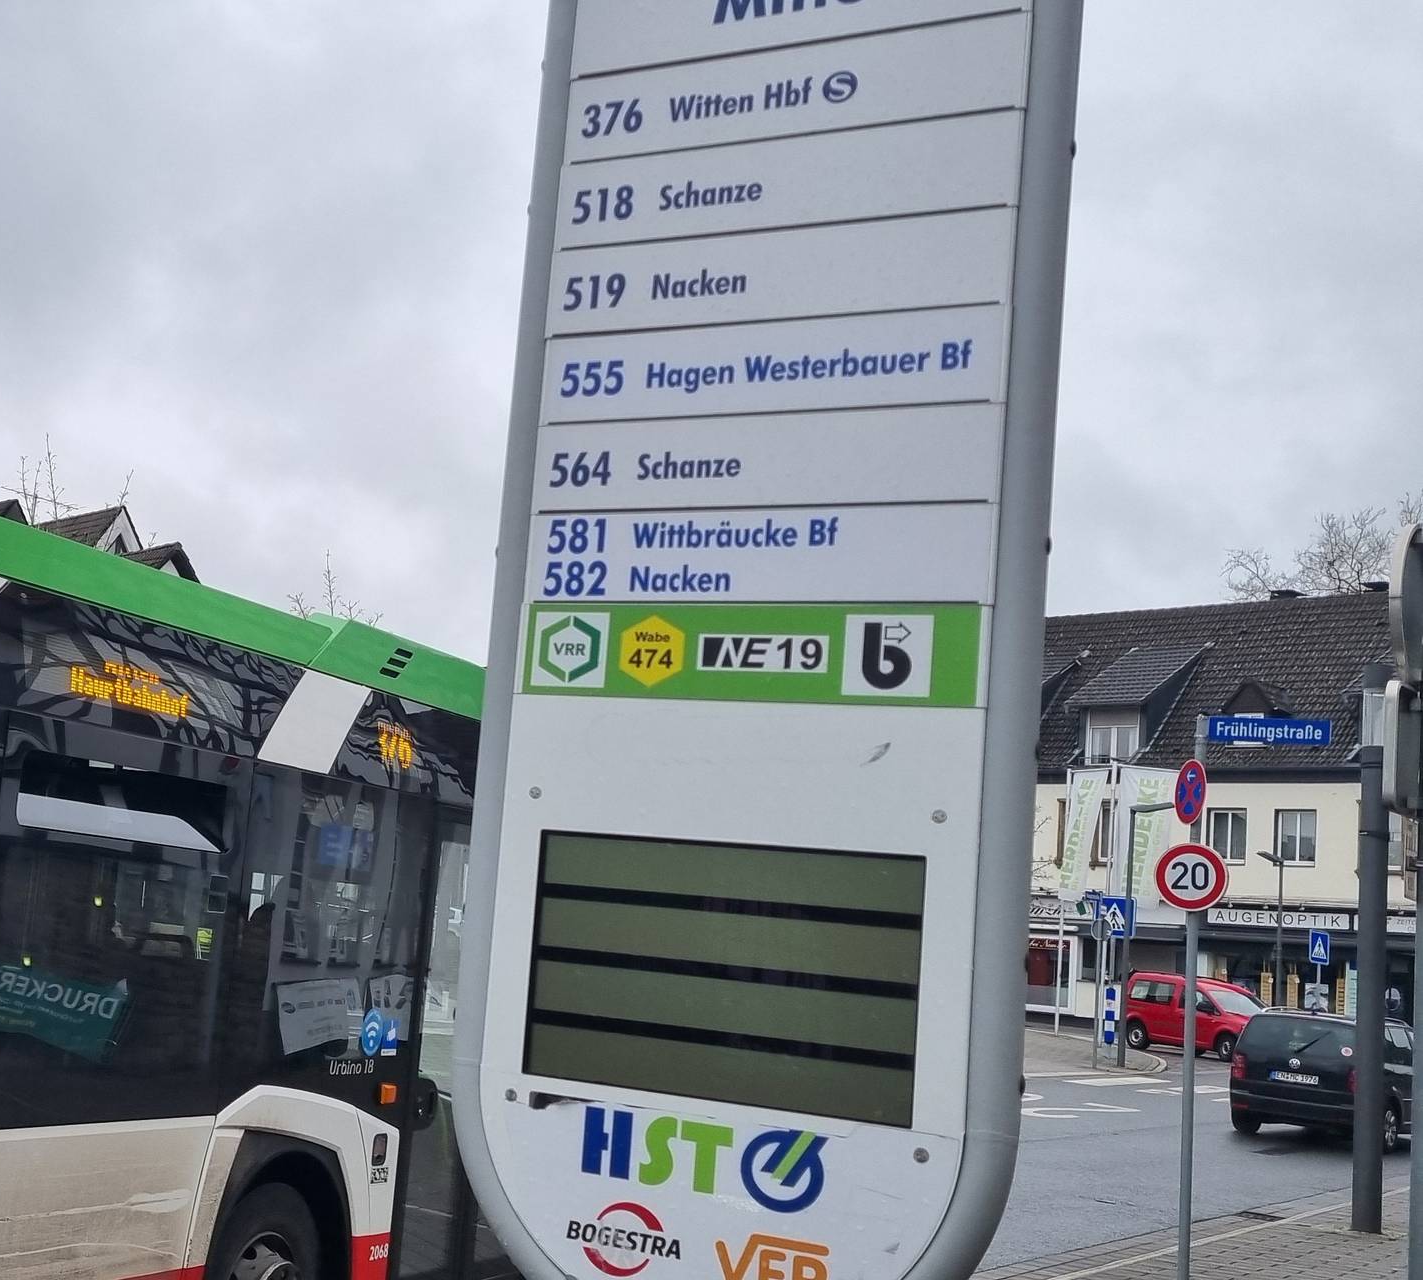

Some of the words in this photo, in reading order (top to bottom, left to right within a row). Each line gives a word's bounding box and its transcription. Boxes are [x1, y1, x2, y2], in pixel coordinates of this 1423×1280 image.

[581, 99, 644, 138] 376
[670, 93, 753, 122] Witten
[764, 76, 812, 110] Hbf
[572, 186, 634, 225] 518
[658, 180, 763, 211] Schanze
[563, 273, 626, 312] 519
[651, 270, 747, 301] Nacken
[560, 360, 624, 398] 555
[646, 356, 734, 393] Hagen
[745, 348, 930, 382] Westerbauer
[940, 340, 973, 370] Bf
[549, 451, 612, 488] 564
[636, 452, 741, 480] Schanze
[546, 518, 606, 554] 581
[632, 519, 798, 549] Wittbräucke
[808, 517, 838, 547] Bf
[543, 560, 607, 597] 582
[629, 566, 731, 593] Nacken
[554, 643, 586, 656] VRR
[635, 630, 671, 644] Wabe
[628, 649, 673, 670] 474
[1216, 721, 1323, 743] Frühlingstraße
[1170, 861, 1210, 891] 20
[1215, 910, 1342, 929] AUGENOPTIK
[329, 1060, 362, 1075] Urbino
[364, 1059, 374, 1073] 18
[581, 1105, 734, 1195] HST
[369, 1243, 389, 1261] 2068
[566, 1220, 681, 1260] BOGESTRA
